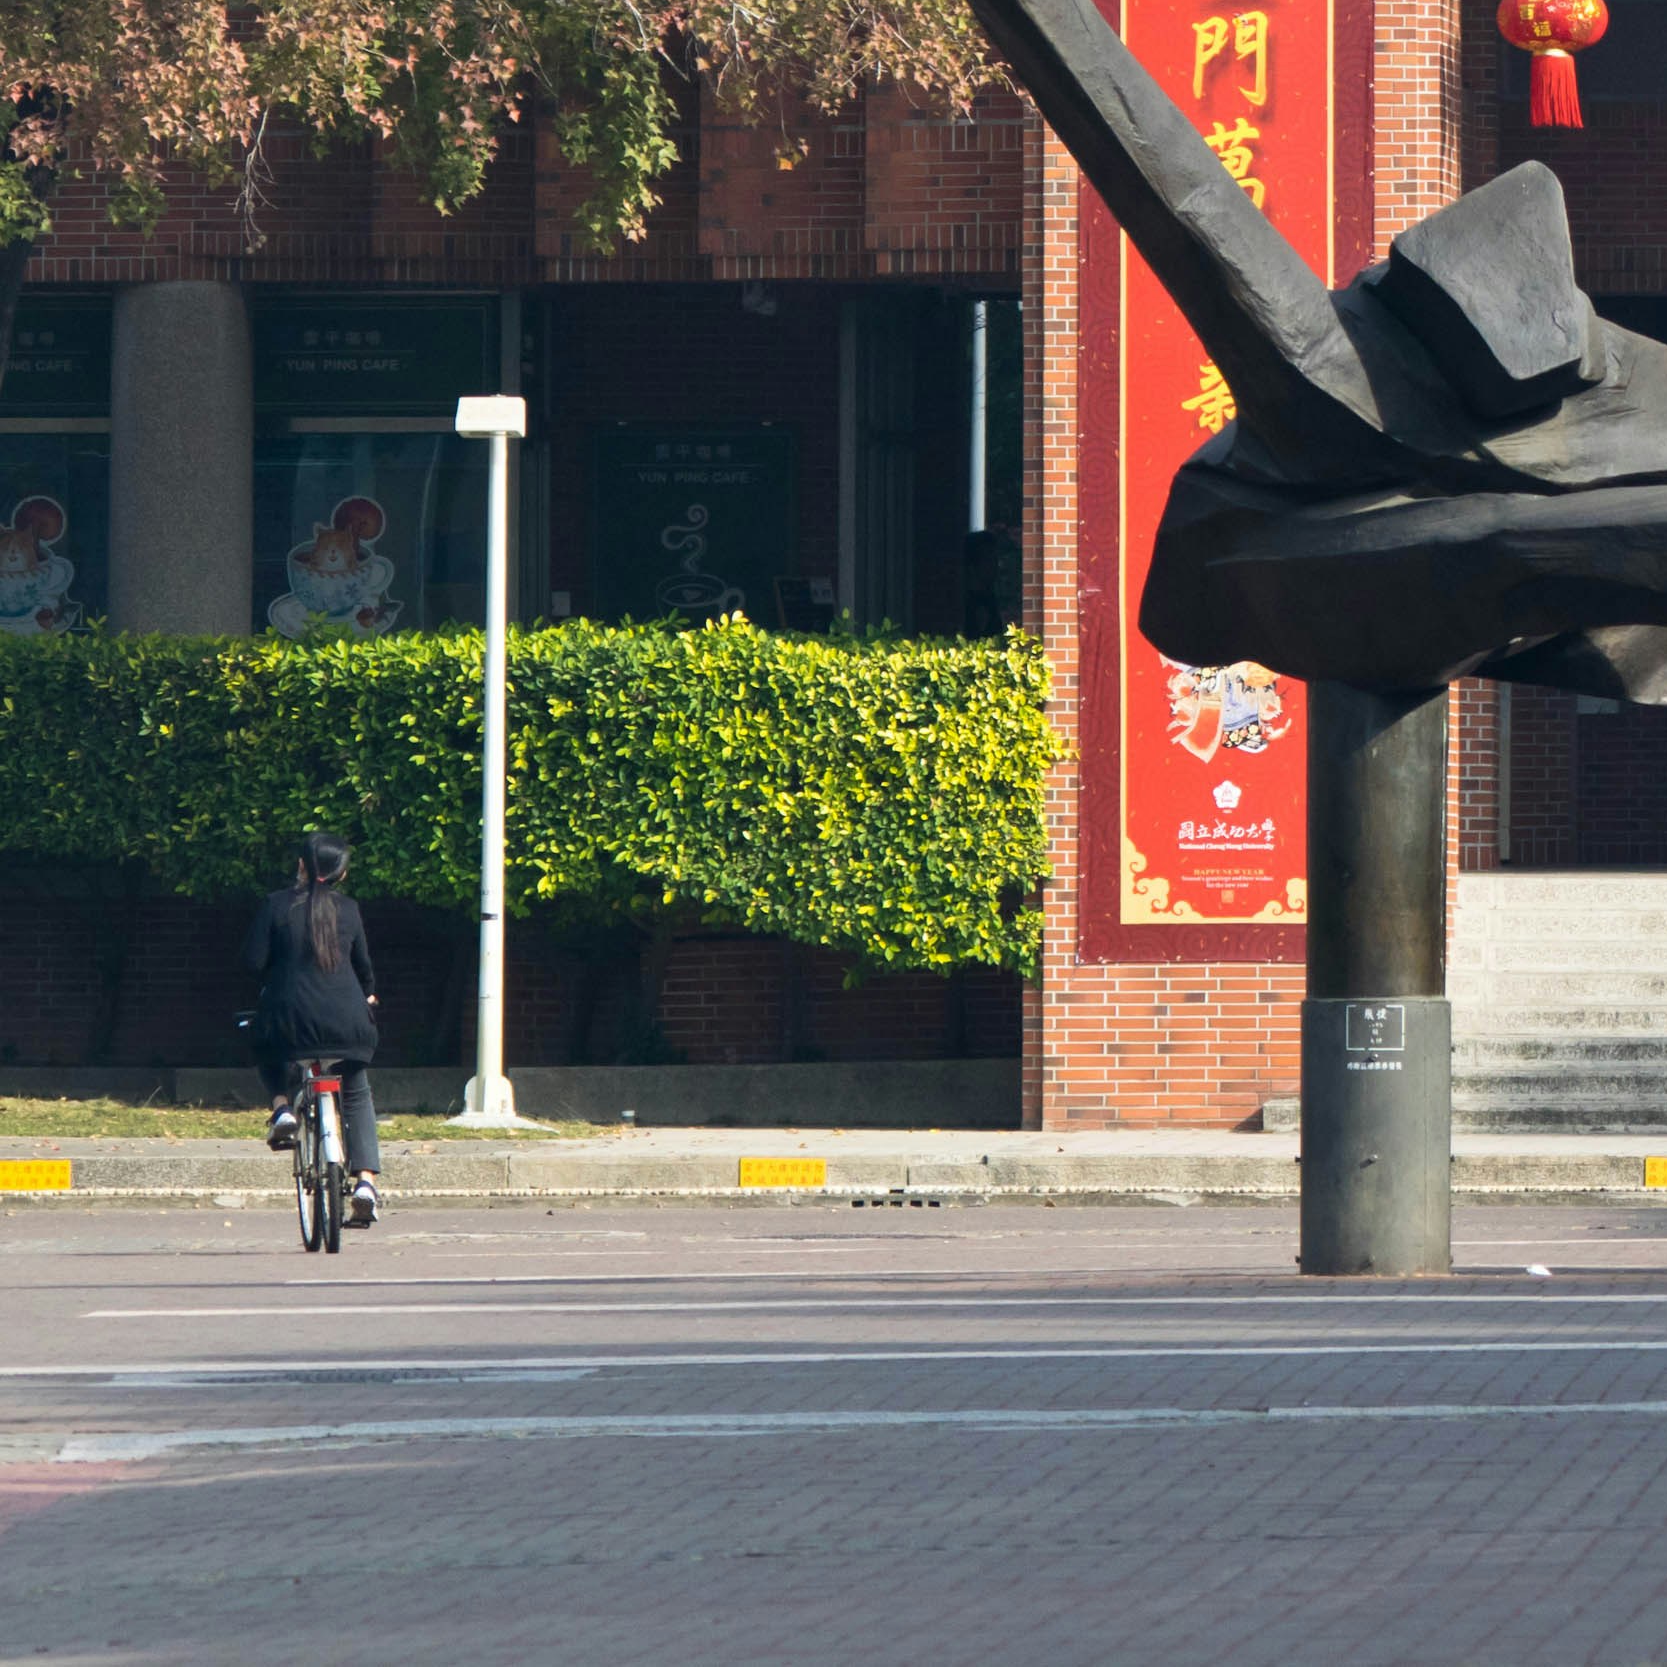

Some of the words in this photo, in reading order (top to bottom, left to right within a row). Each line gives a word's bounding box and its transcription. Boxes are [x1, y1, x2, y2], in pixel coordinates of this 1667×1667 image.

[35, 357, 73, 372] CAFE
[287, 357, 316, 372] YUN
[322, 357, 359, 372] PING
[361, 357, 401, 372] CAFE
[637, 470, 667, 484] YUN
[712, 470, 752, 484] CAFE
